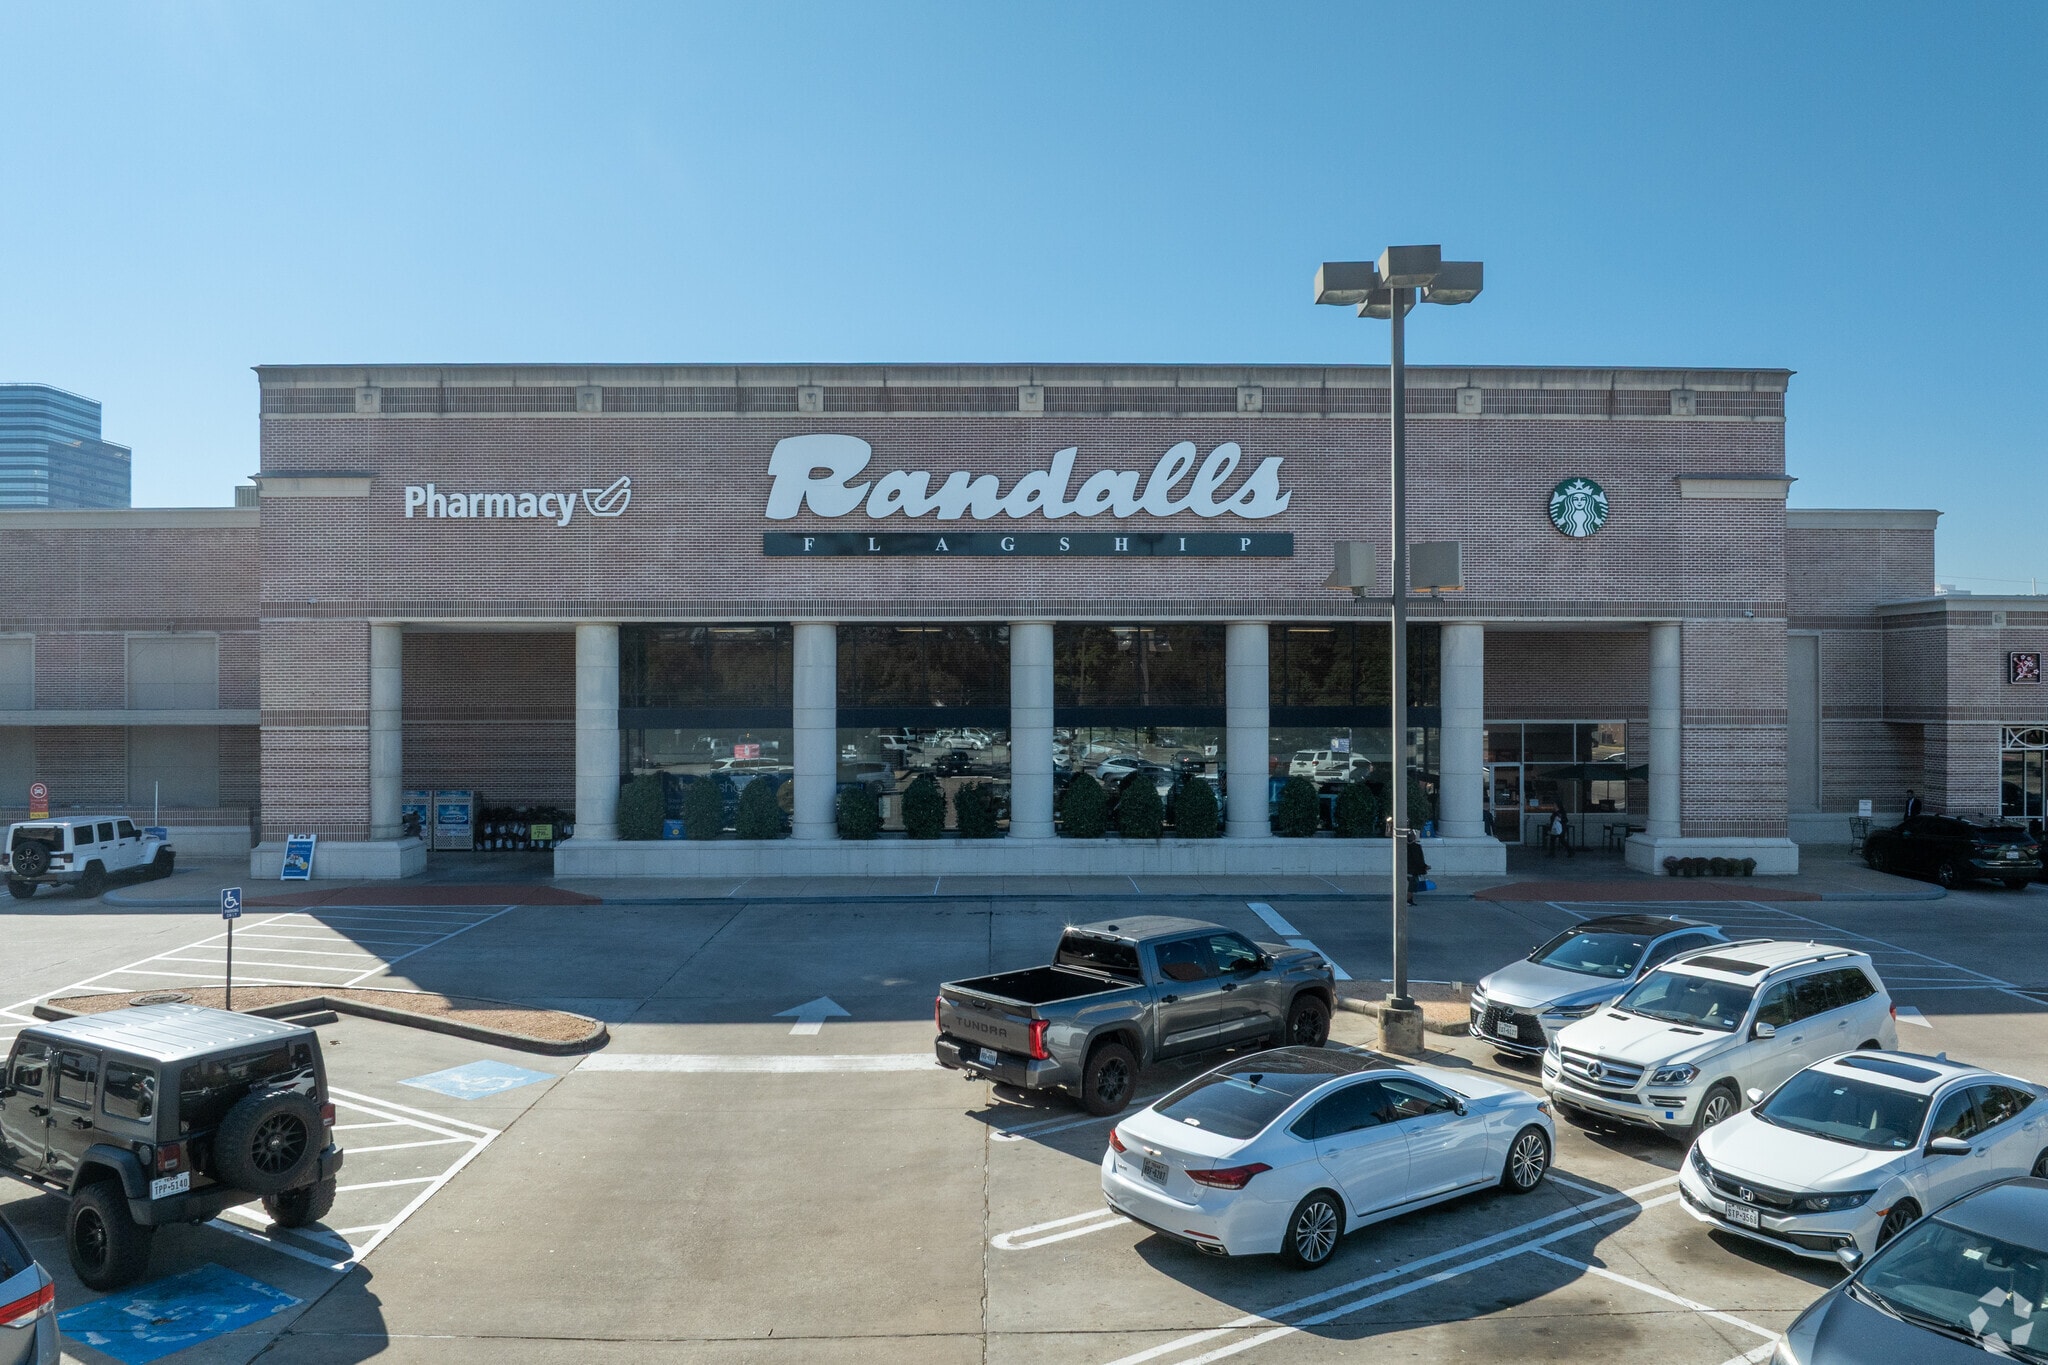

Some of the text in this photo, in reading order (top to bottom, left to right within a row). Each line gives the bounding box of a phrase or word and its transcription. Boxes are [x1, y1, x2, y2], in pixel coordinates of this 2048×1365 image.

[764, 434, 1293, 520] Randalls
[405, 484, 577, 526] Pharmacy
[803, 537, 1251, 552] FLAGSHIP
[956, 1016, 1007, 1038] TUNDRA
